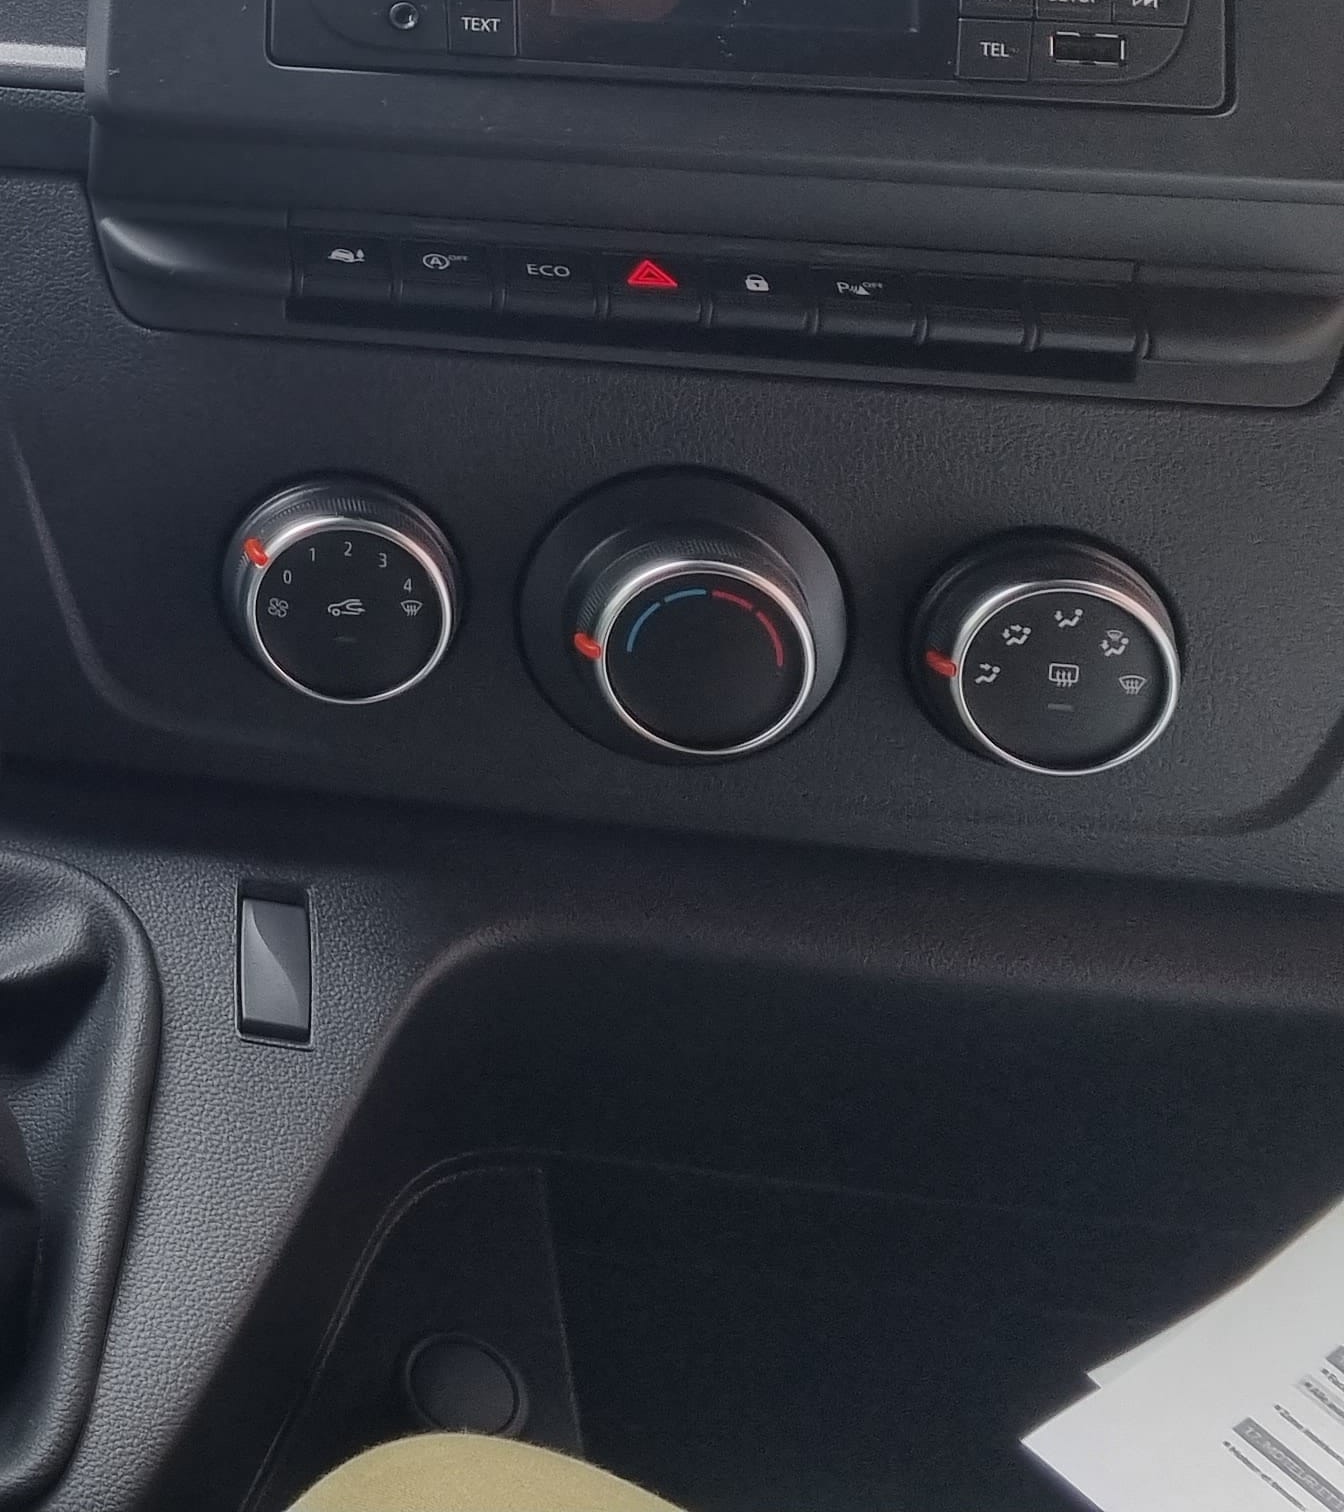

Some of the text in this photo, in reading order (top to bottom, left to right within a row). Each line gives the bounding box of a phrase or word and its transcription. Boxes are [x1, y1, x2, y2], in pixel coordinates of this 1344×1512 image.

[461, 16, 501, 33] TEXT
[980, 41, 1010, 58] TEL
[526, 263, 571, 277] ECO
[309, 547, 316, 561] 1
[343, 541, 353, 557] 2
[378, 553, 388, 568] 3
[282, 570, 293, 585] 0
[403, 577, 413, 593] 4
